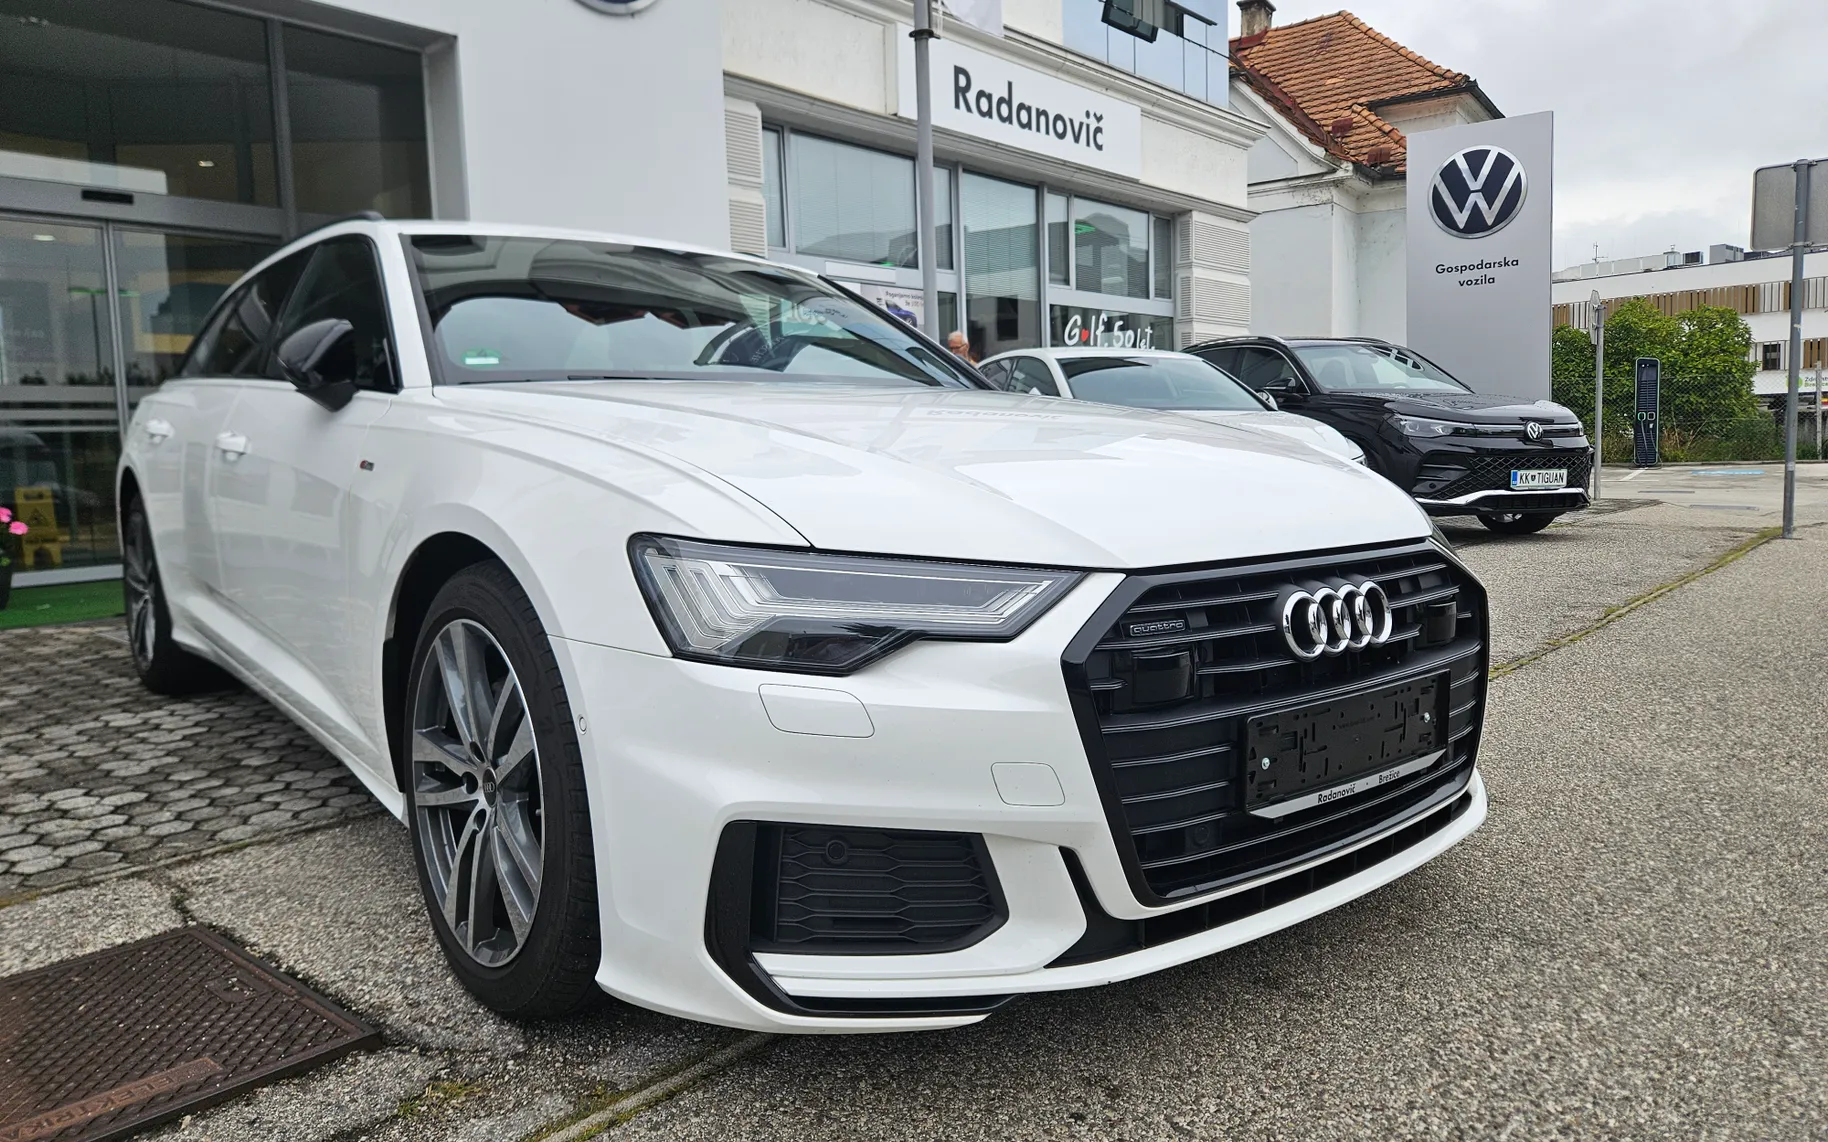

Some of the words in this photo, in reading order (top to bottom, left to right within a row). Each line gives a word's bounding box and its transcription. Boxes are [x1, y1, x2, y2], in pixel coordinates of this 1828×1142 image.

[953, 64, 1104, 152] Radanovič
[1435, 256, 1519, 274] Gospodarska
[1458, 273, 1495, 287] vozila
[1113, 320, 1135, 348] 50
[1519, 472, 1531, 484] KK
[1537, 472, 1564, 484] TIGUAN
[1133, 622, 1184, 634] quattro
[1317, 783, 1356, 804] Radanovič
[1378, 770, 1400, 784] Brežice
